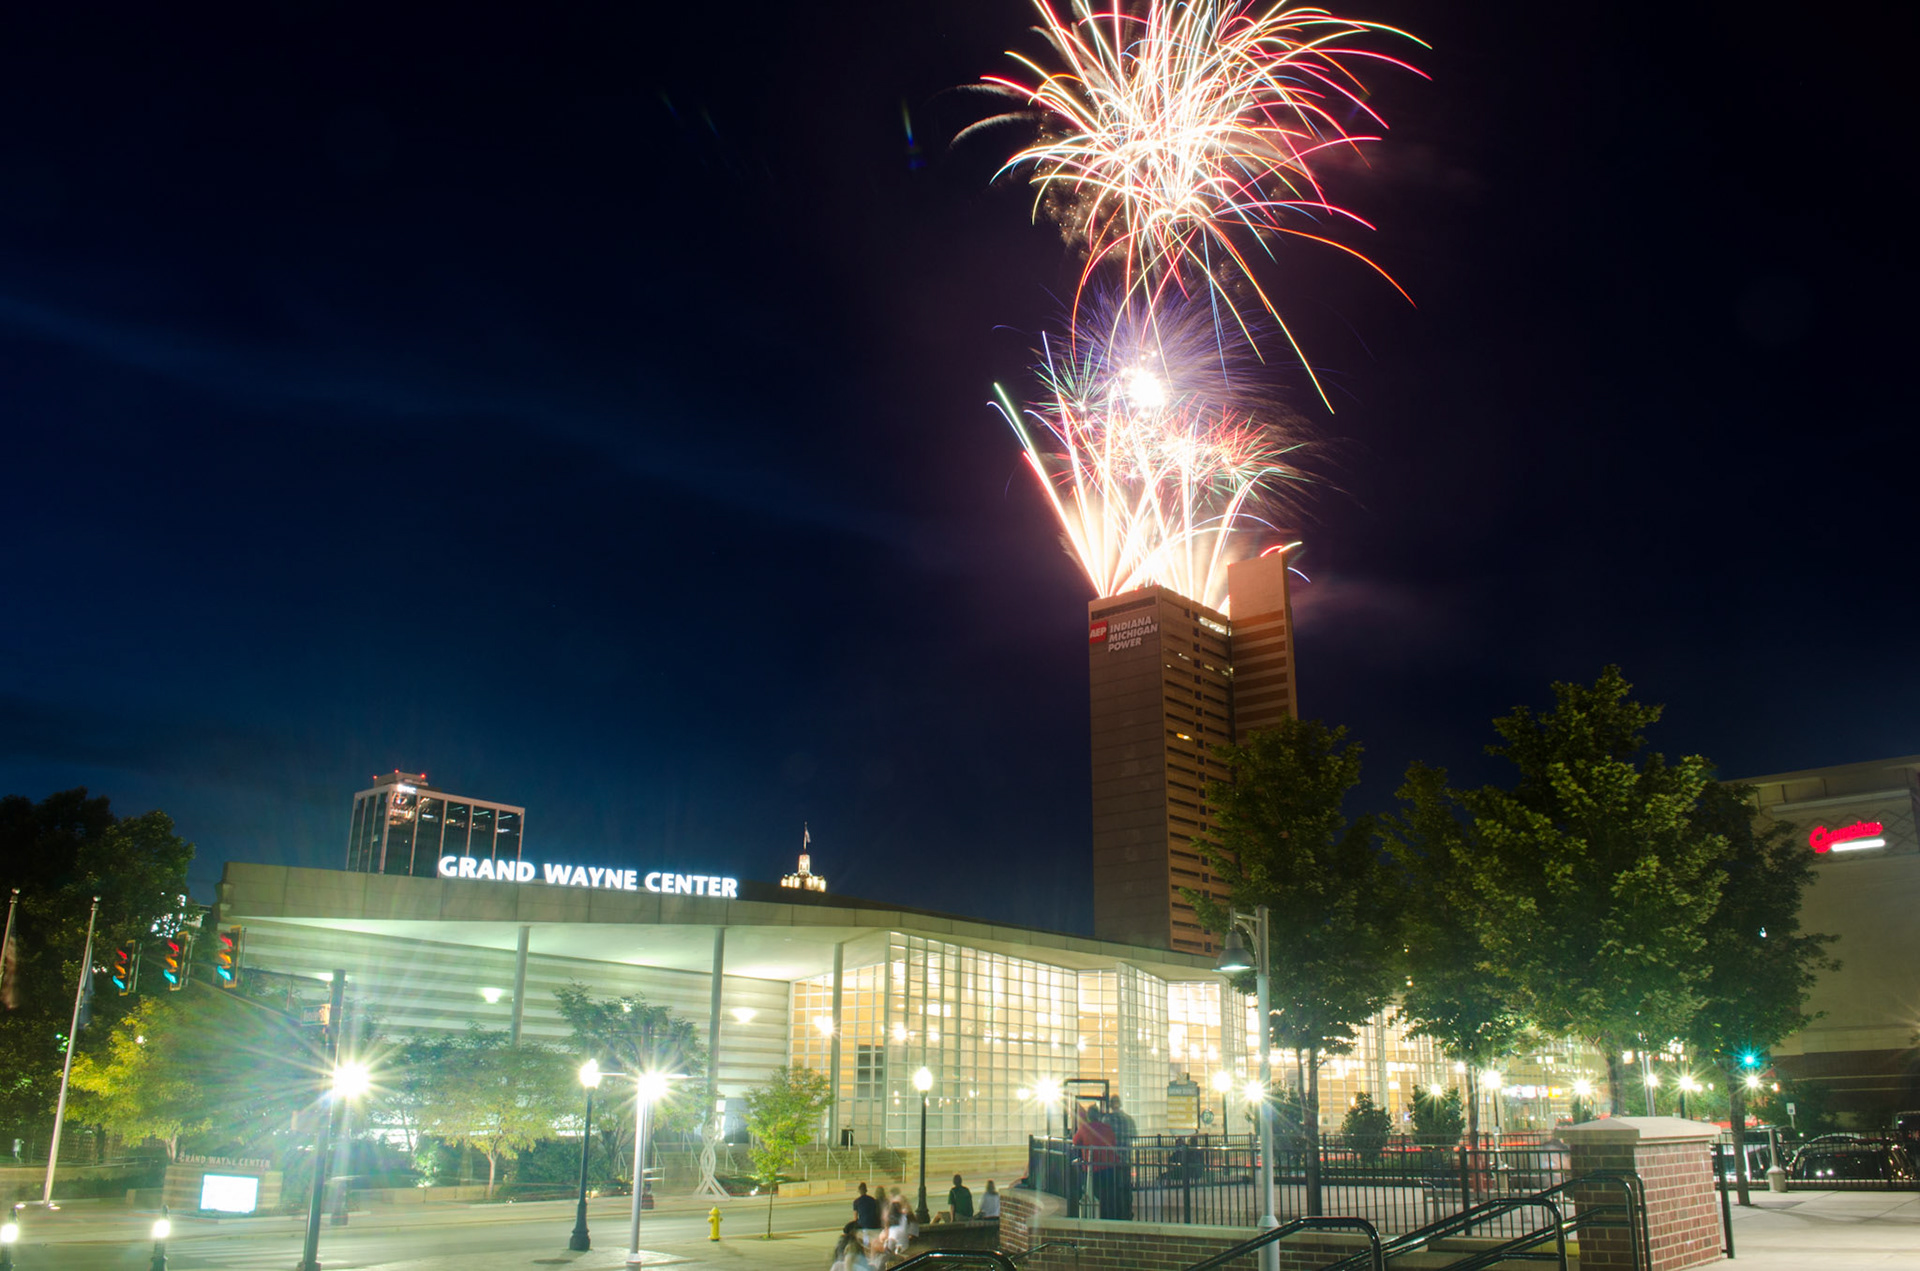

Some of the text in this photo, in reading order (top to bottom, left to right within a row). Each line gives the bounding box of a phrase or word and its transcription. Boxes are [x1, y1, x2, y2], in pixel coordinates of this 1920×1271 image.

[1090, 627, 1107, 637] AEP
[1109, 624, 1158, 642] MICHIGAN
[1110, 616, 1152, 633] INDIANA
[1108, 637, 1142, 652] POWER
[439, 856, 738, 898] GRAND WAYNE CENTER
